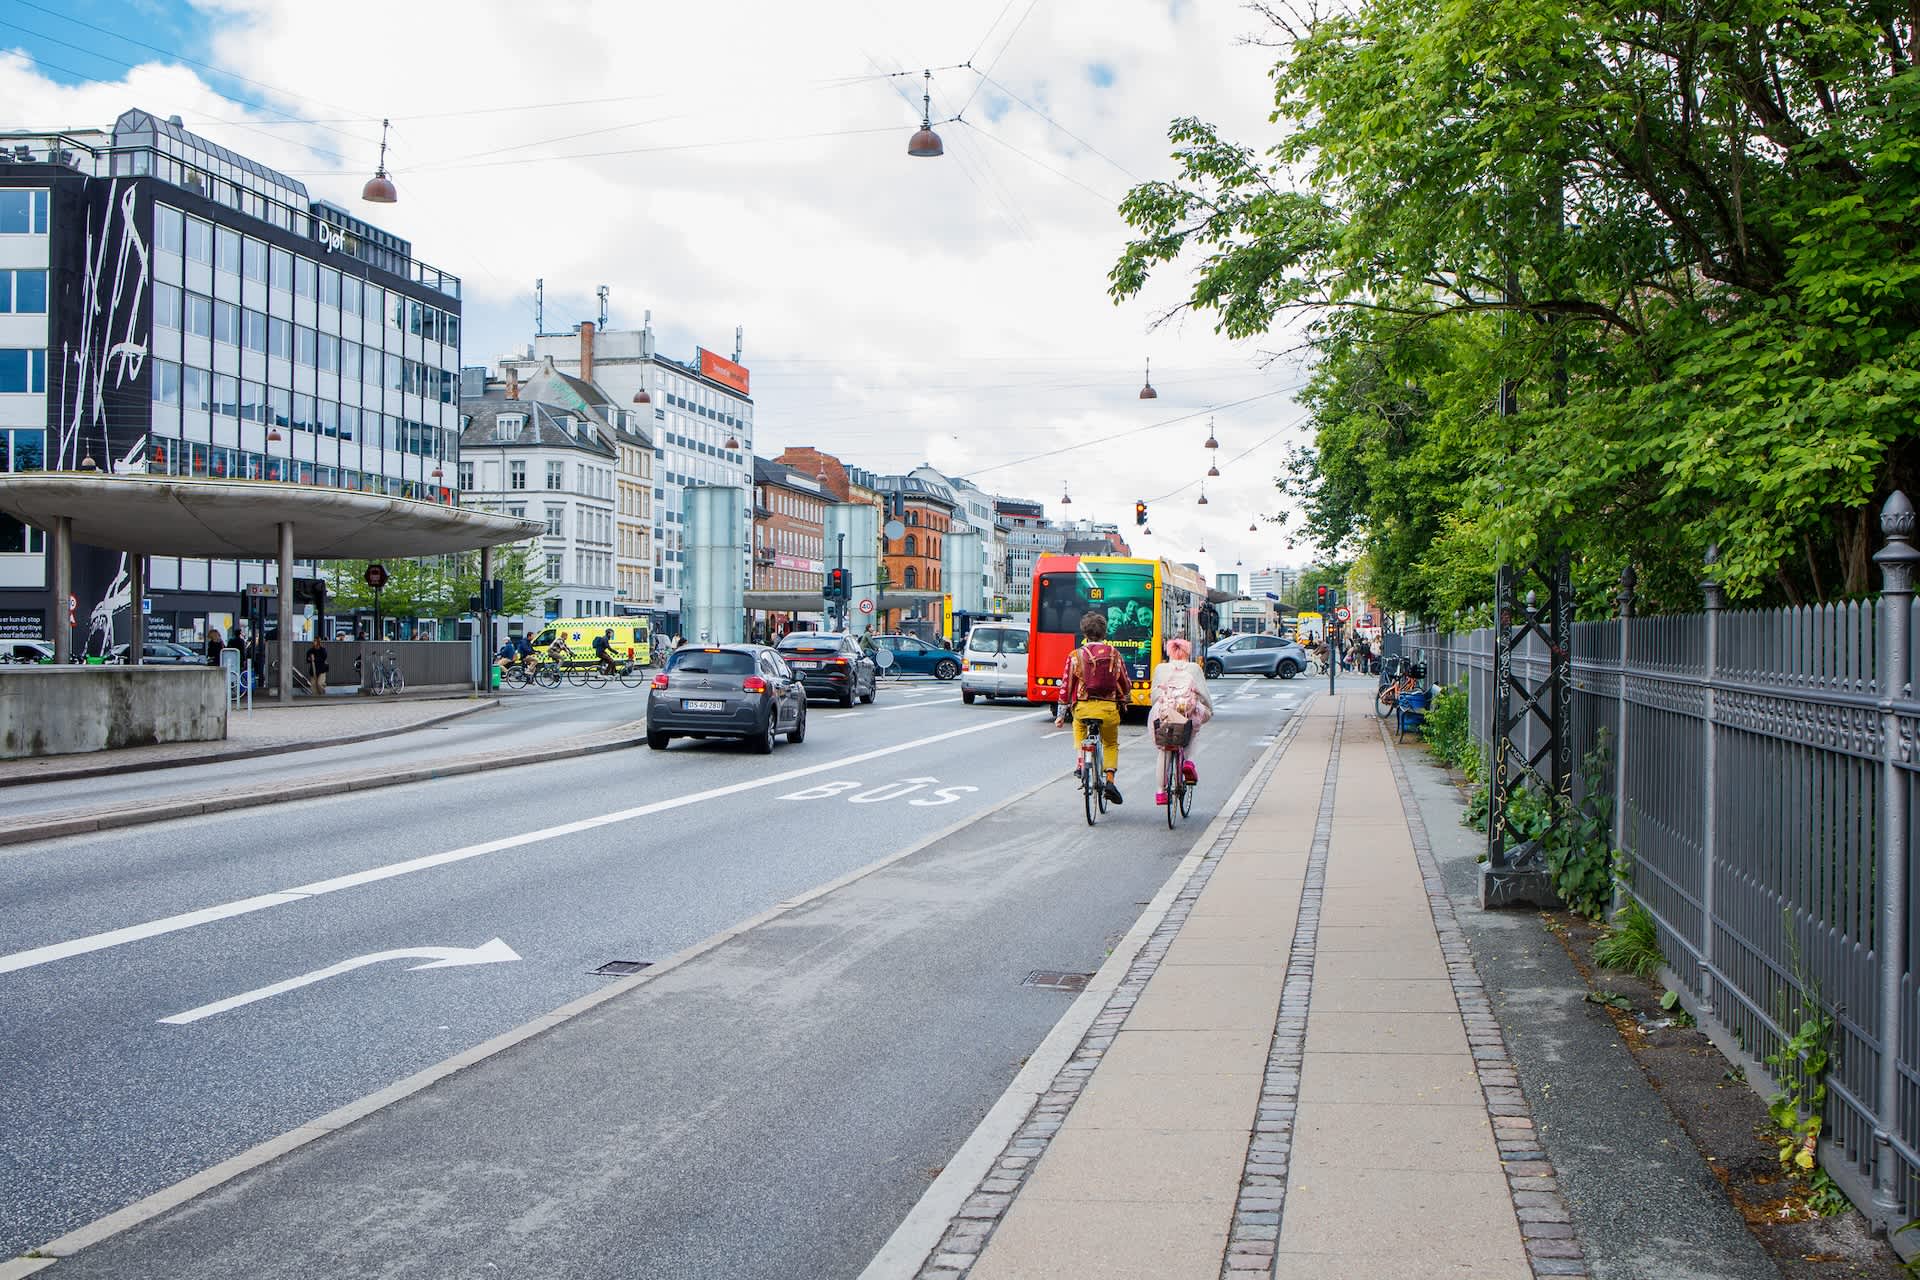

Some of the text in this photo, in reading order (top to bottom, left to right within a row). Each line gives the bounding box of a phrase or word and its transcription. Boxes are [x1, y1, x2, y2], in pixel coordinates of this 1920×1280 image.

[319, 220, 346, 253] Djøf
[1091, 589, 1102, 599] 6A
[27, 616, 41, 624] stop
[776, 776, 979, 806] BUS
